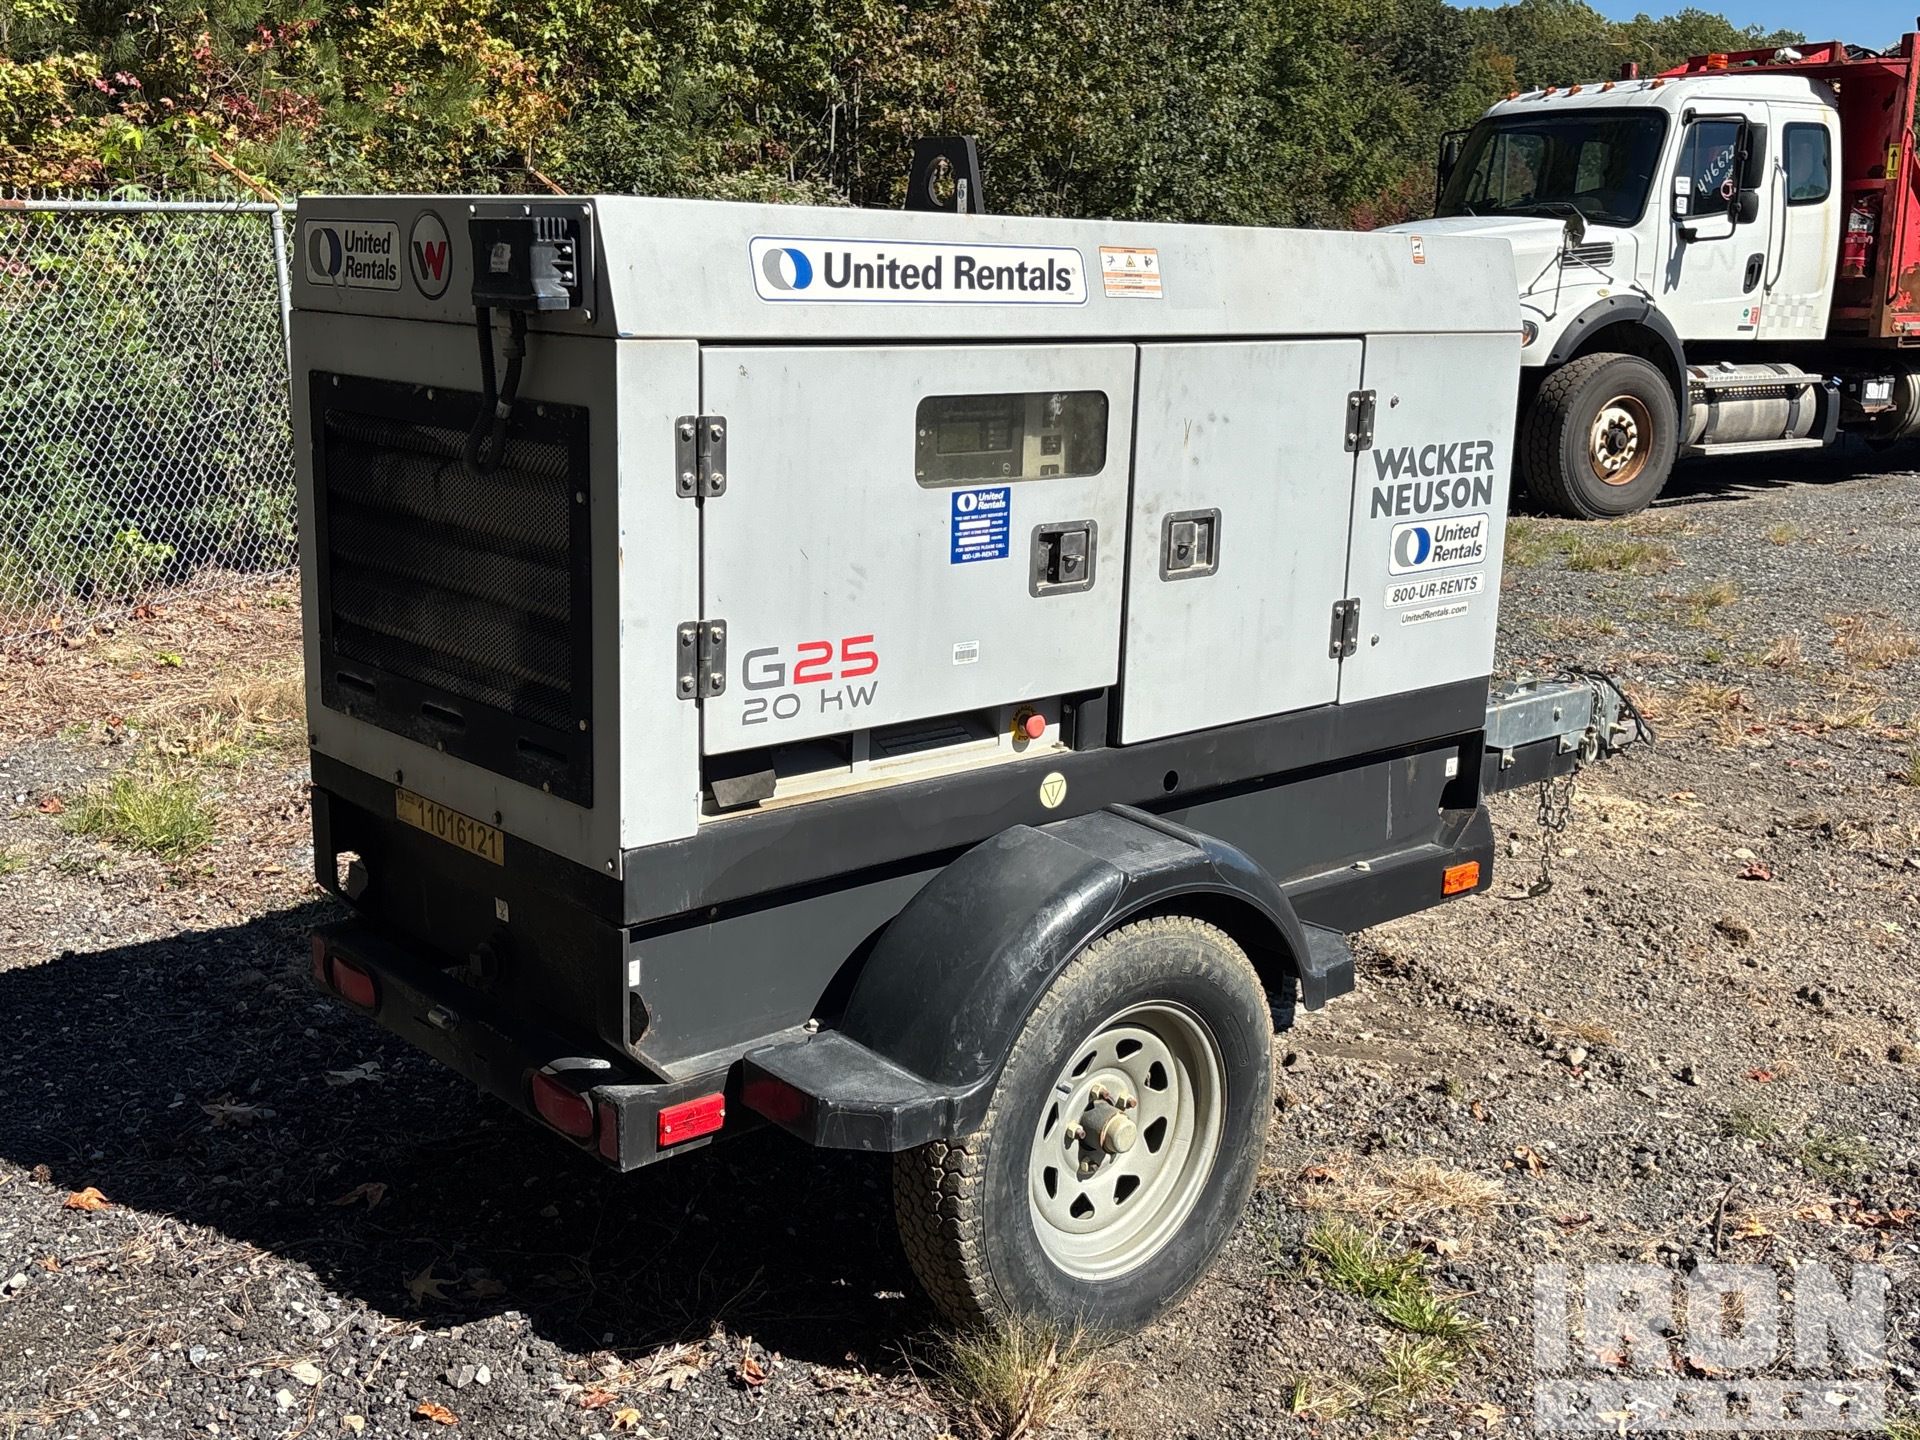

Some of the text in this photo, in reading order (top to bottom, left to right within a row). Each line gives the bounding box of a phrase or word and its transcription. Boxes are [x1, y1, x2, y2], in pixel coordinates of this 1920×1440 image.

[1697, 143, 1736, 193] 446672
[344, 230, 391, 254] United
[345, 256, 397, 281] Rentals
[824, 252, 1072, 291] United Rentals
[1372, 440, 1495, 481] WACKER
[977, 500, 1006, 510] Rentals
[978, 491, 1005, 501] United
[1370, 475, 1494, 519] NEUSON
[1434, 520, 1482, 543] United
[1432, 540, 1483, 563] Rentals
[1392, 576, 1478, 603] 800-UR-RENTS
[1401, 605, 1467, 623] UnitedRentals.com
[742, 634, 879, 691] G25
[742, 693, 801, 726] 20
[418, 799, 496, 859] 11016121
